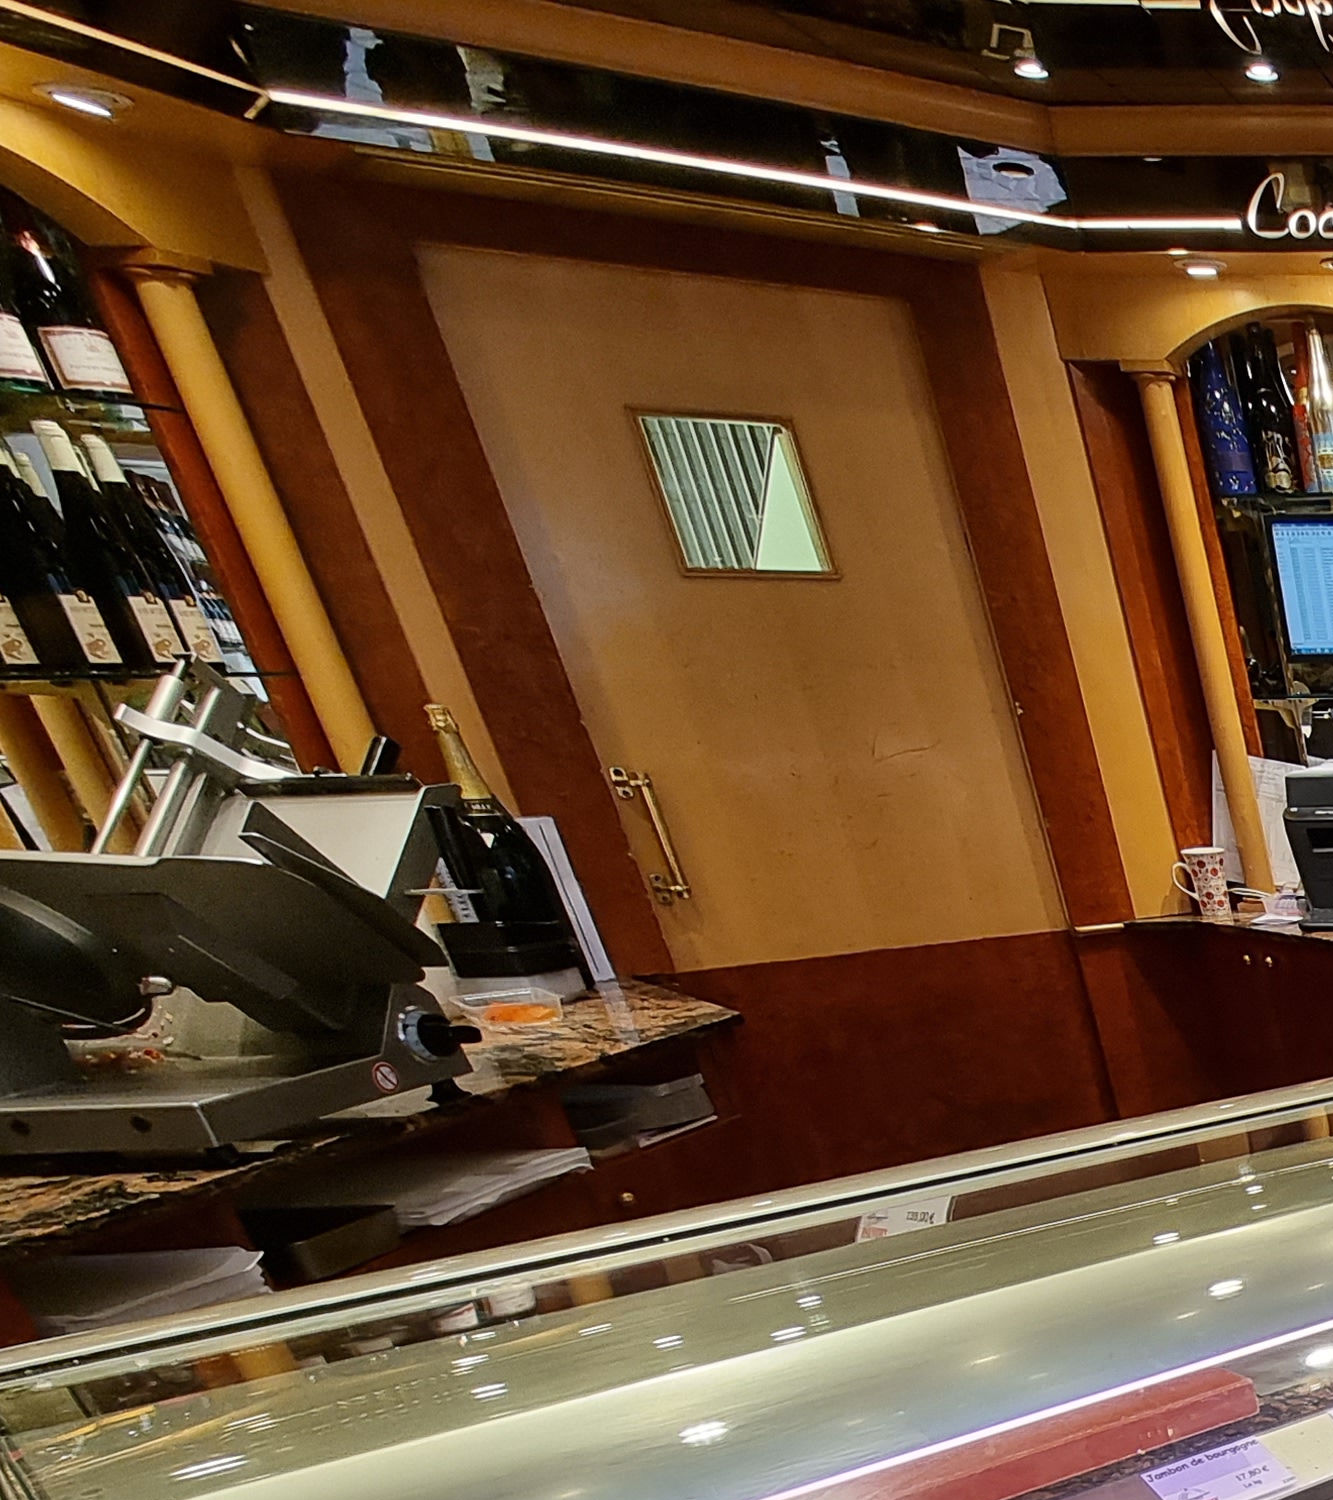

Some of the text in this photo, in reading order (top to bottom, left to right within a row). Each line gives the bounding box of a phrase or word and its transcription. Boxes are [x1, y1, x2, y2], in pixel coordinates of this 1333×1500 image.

[1145, 1438, 1260, 1483] Jambon de bourgogne
